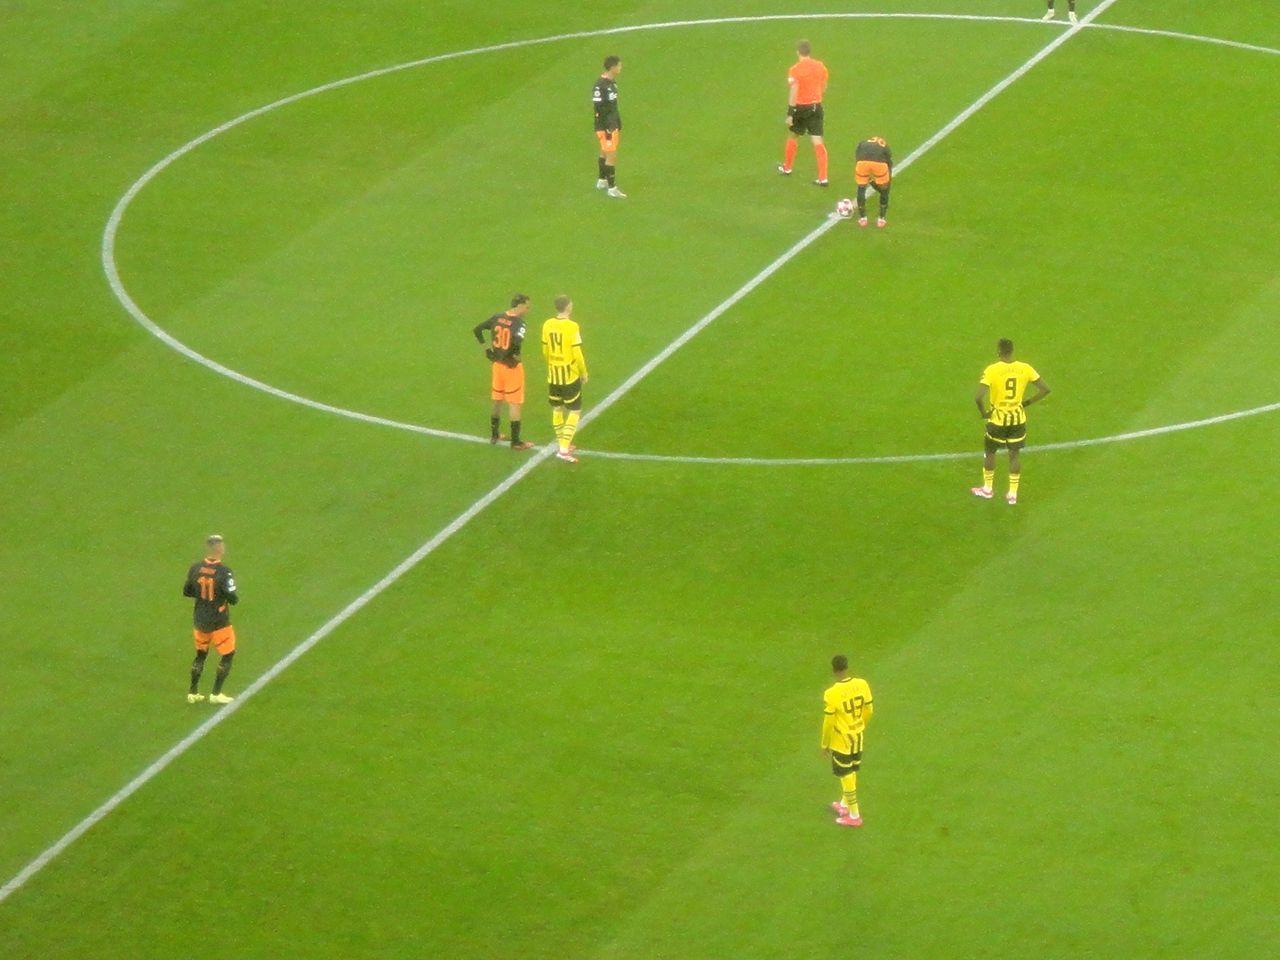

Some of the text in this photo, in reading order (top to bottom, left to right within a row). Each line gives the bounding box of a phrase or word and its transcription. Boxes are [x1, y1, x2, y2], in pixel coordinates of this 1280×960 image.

[493, 325, 511, 350] 30
[550, 332, 563, 353] 14
[1005, 377, 1017, 400] 9
[197, 576, 215, 601] 11
[842, 695, 864, 719] 43
